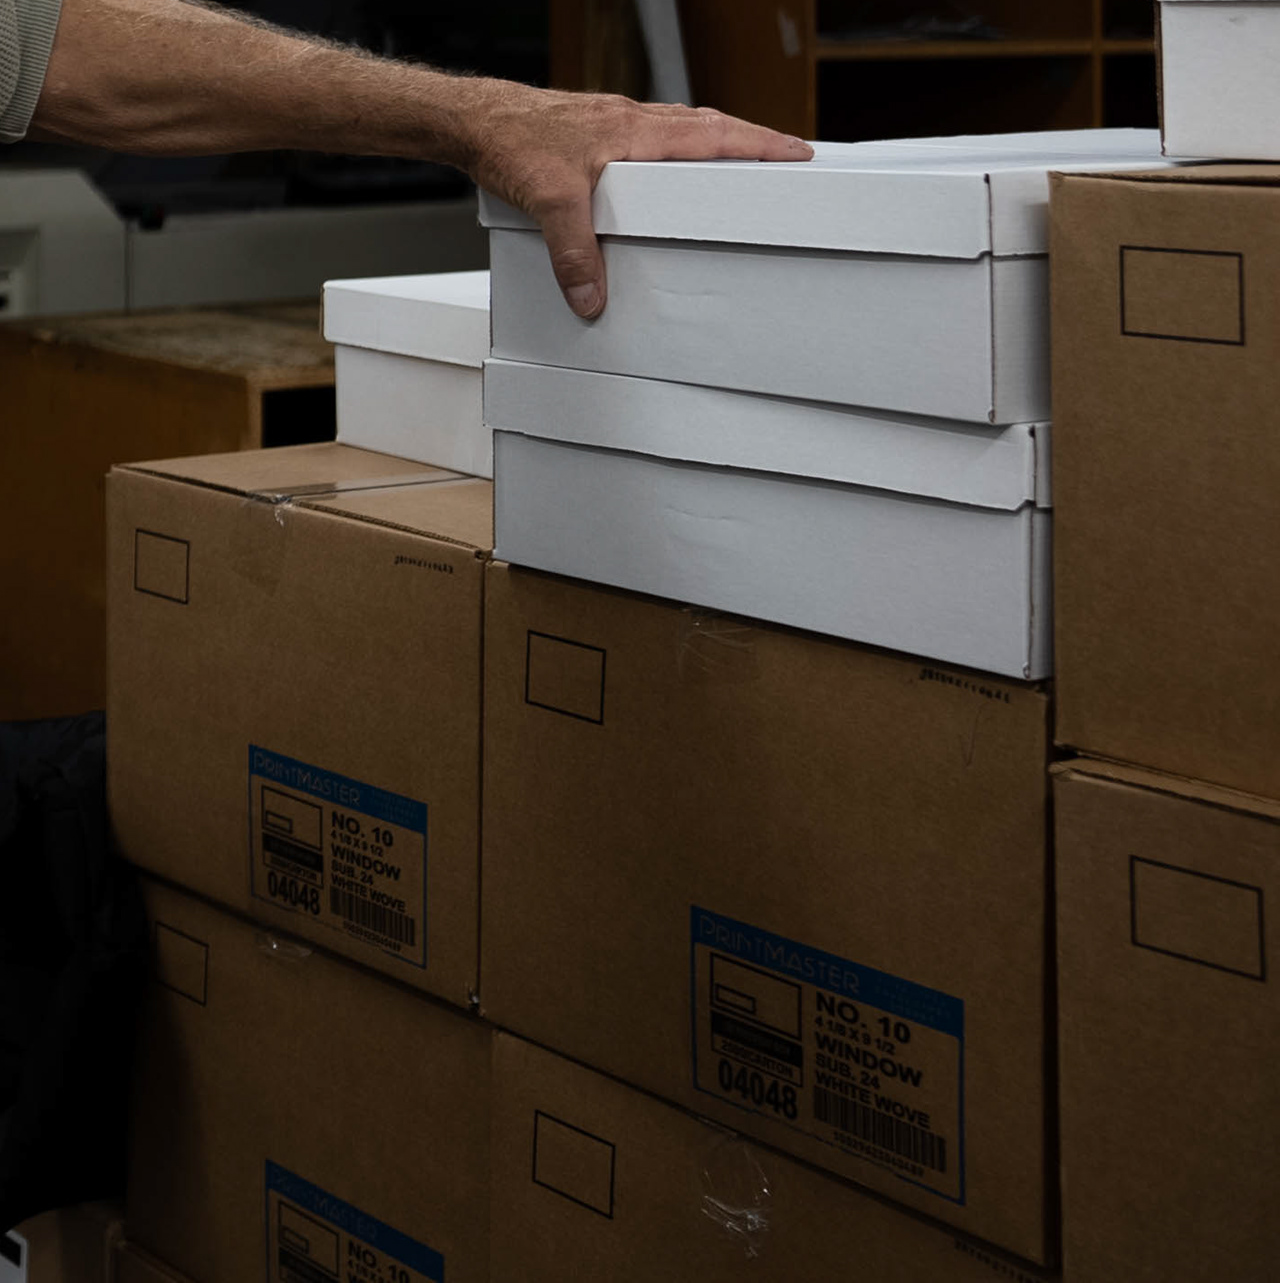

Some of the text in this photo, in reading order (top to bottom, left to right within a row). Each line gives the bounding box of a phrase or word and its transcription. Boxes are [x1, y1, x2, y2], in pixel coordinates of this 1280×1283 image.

[253, 751, 361, 807] PRINTMASTER
[332, 810, 394, 847] NO. 10
[331, 842, 401, 881] WINDOW
[267, 871, 321, 915] 04048
[331, 873, 407, 913] WHITE WOVE
[699, 916, 861, 995] PRINTMASTER
[815, 991, 867, 1029] NO.
[878, 1017, 911, 1044] 10
[815, 1032, 923, 1088] WINDOW
[815, 1053, 881, 1091] SUB. 24
[718, 1059, 799, 1120] 04048
[815, 1070, 931, 1131] WHITE WOVE
[348, 1240, 382, 1272] NO.
[389, 1264, 410, 1283] 10
